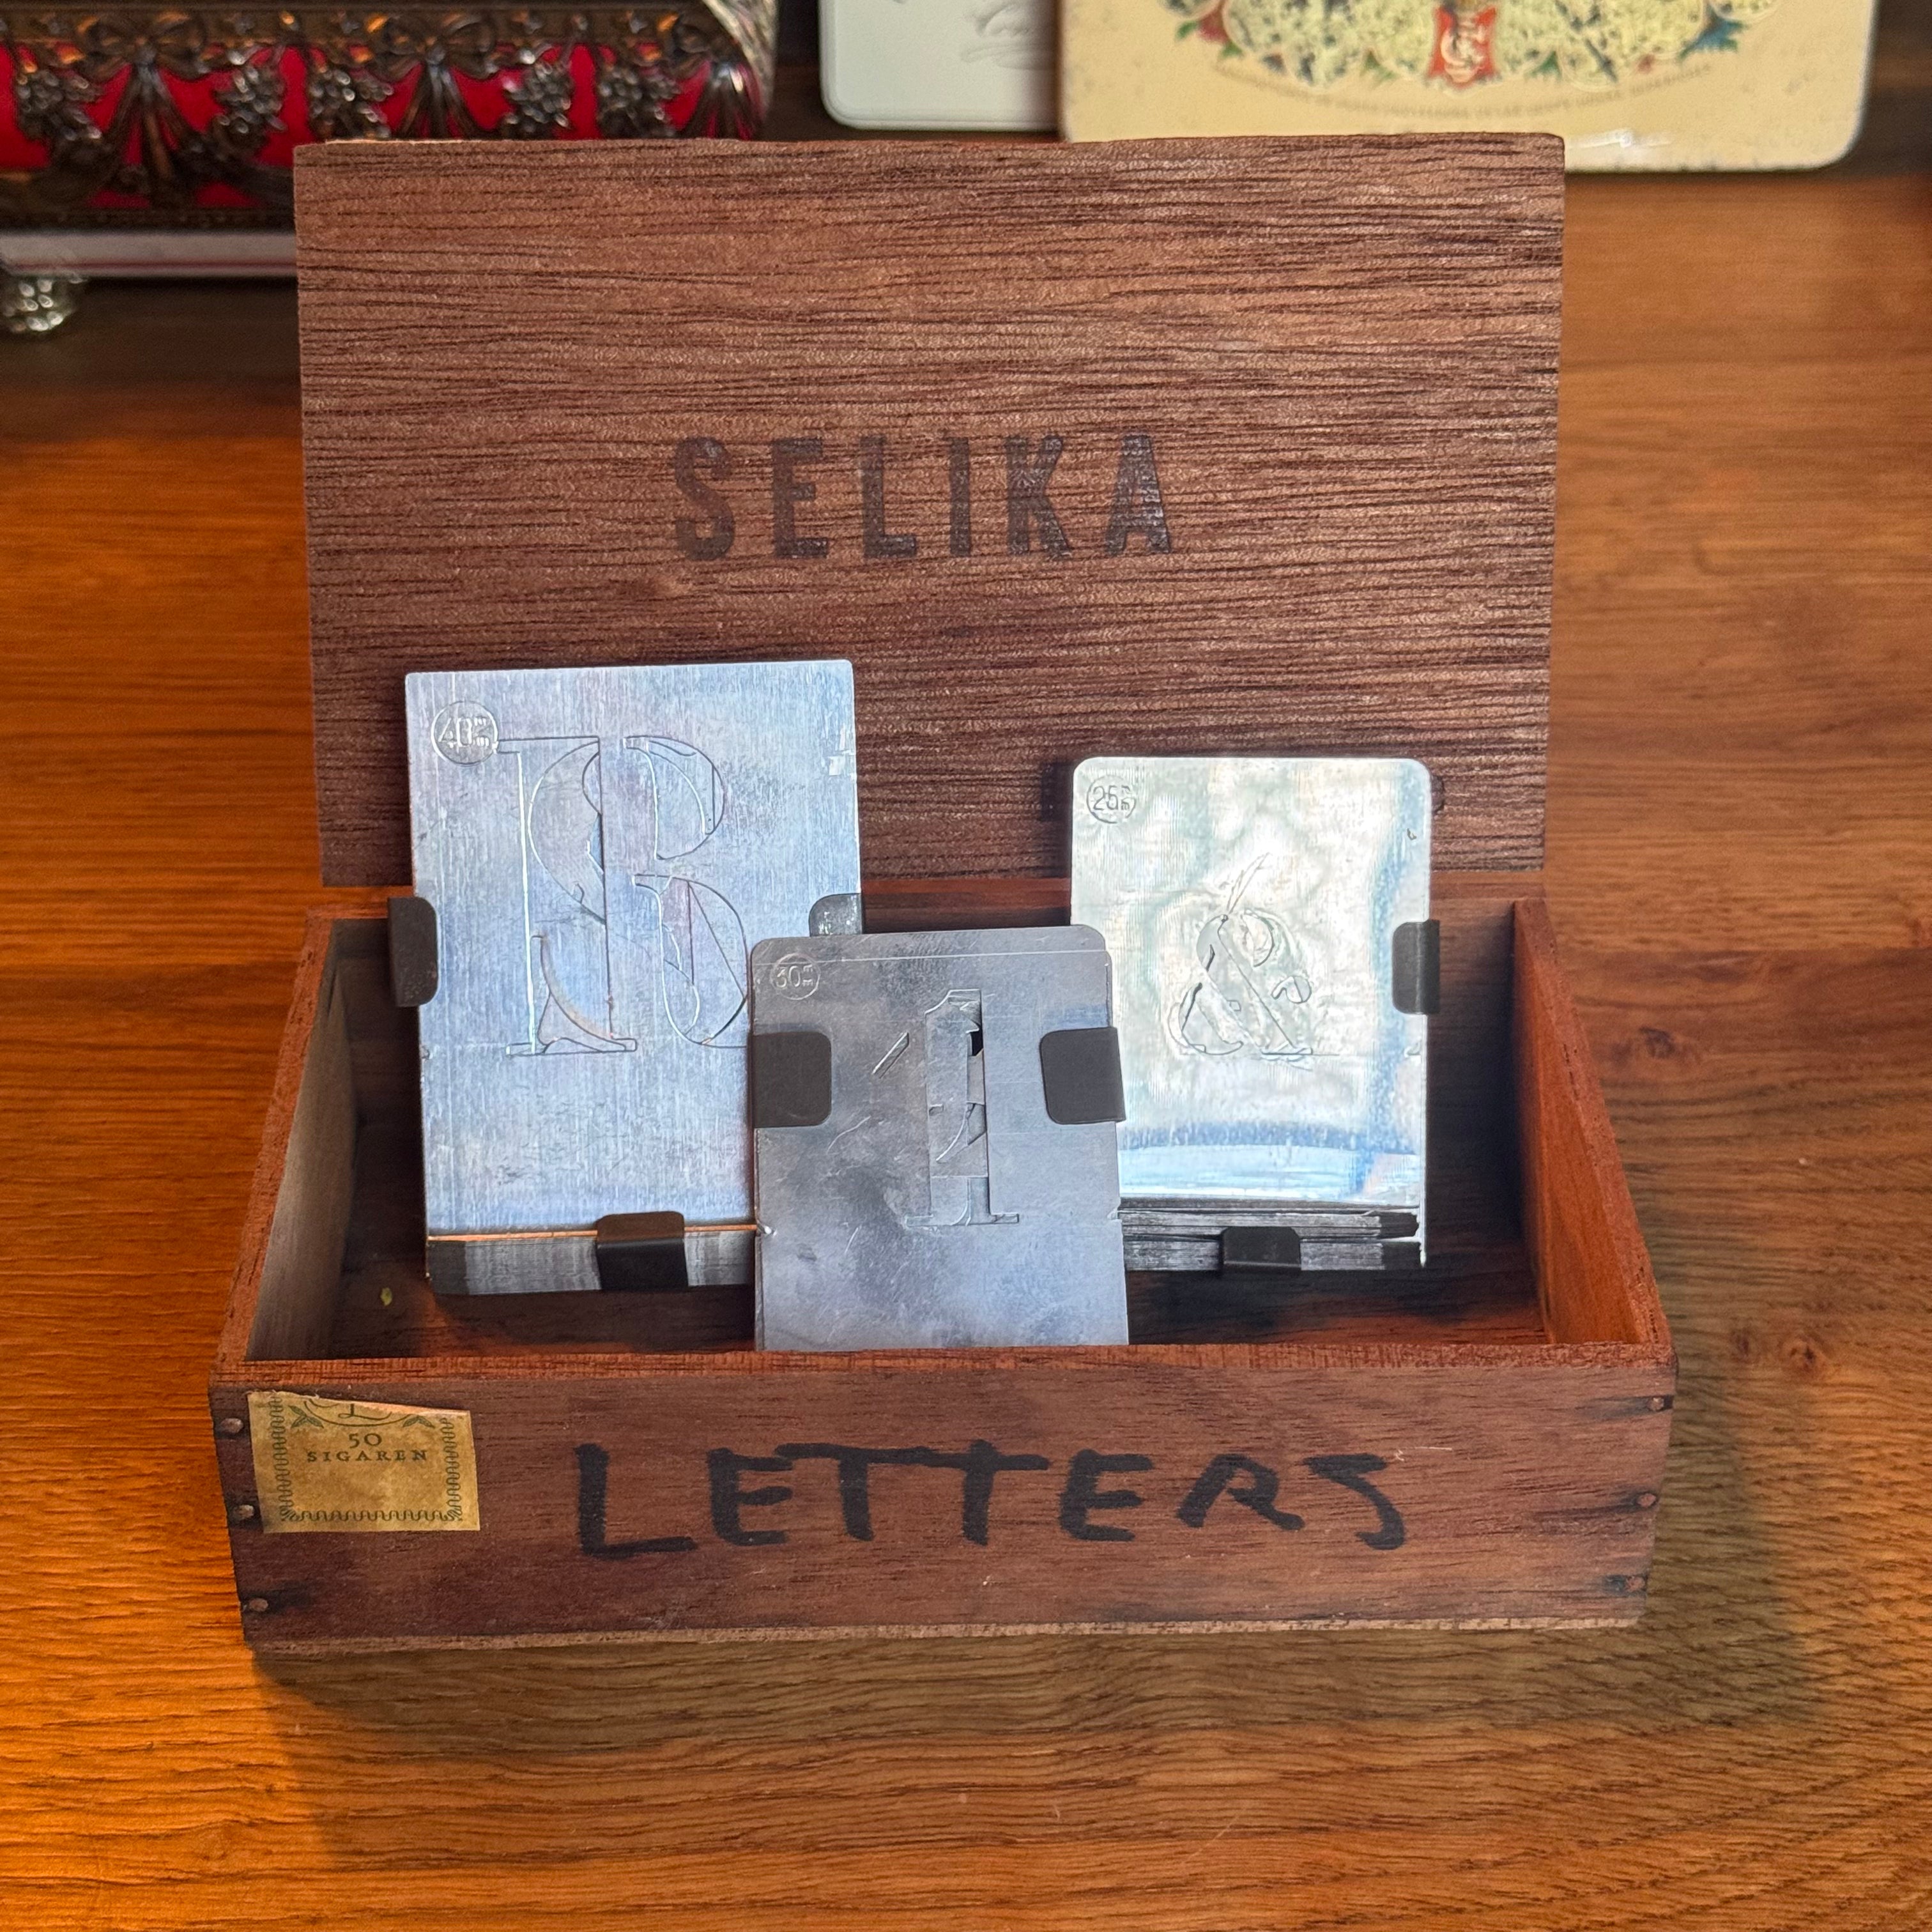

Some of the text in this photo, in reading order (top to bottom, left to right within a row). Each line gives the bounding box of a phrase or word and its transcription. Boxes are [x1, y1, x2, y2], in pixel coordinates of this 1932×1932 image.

[673, 434, 1172, 561] SELIKA
[306, 1448, 427, 1462] SIGAREN
[348, 1432, 383, 1449] 50
[574, 1439, 1404, 1556] LETTERS
